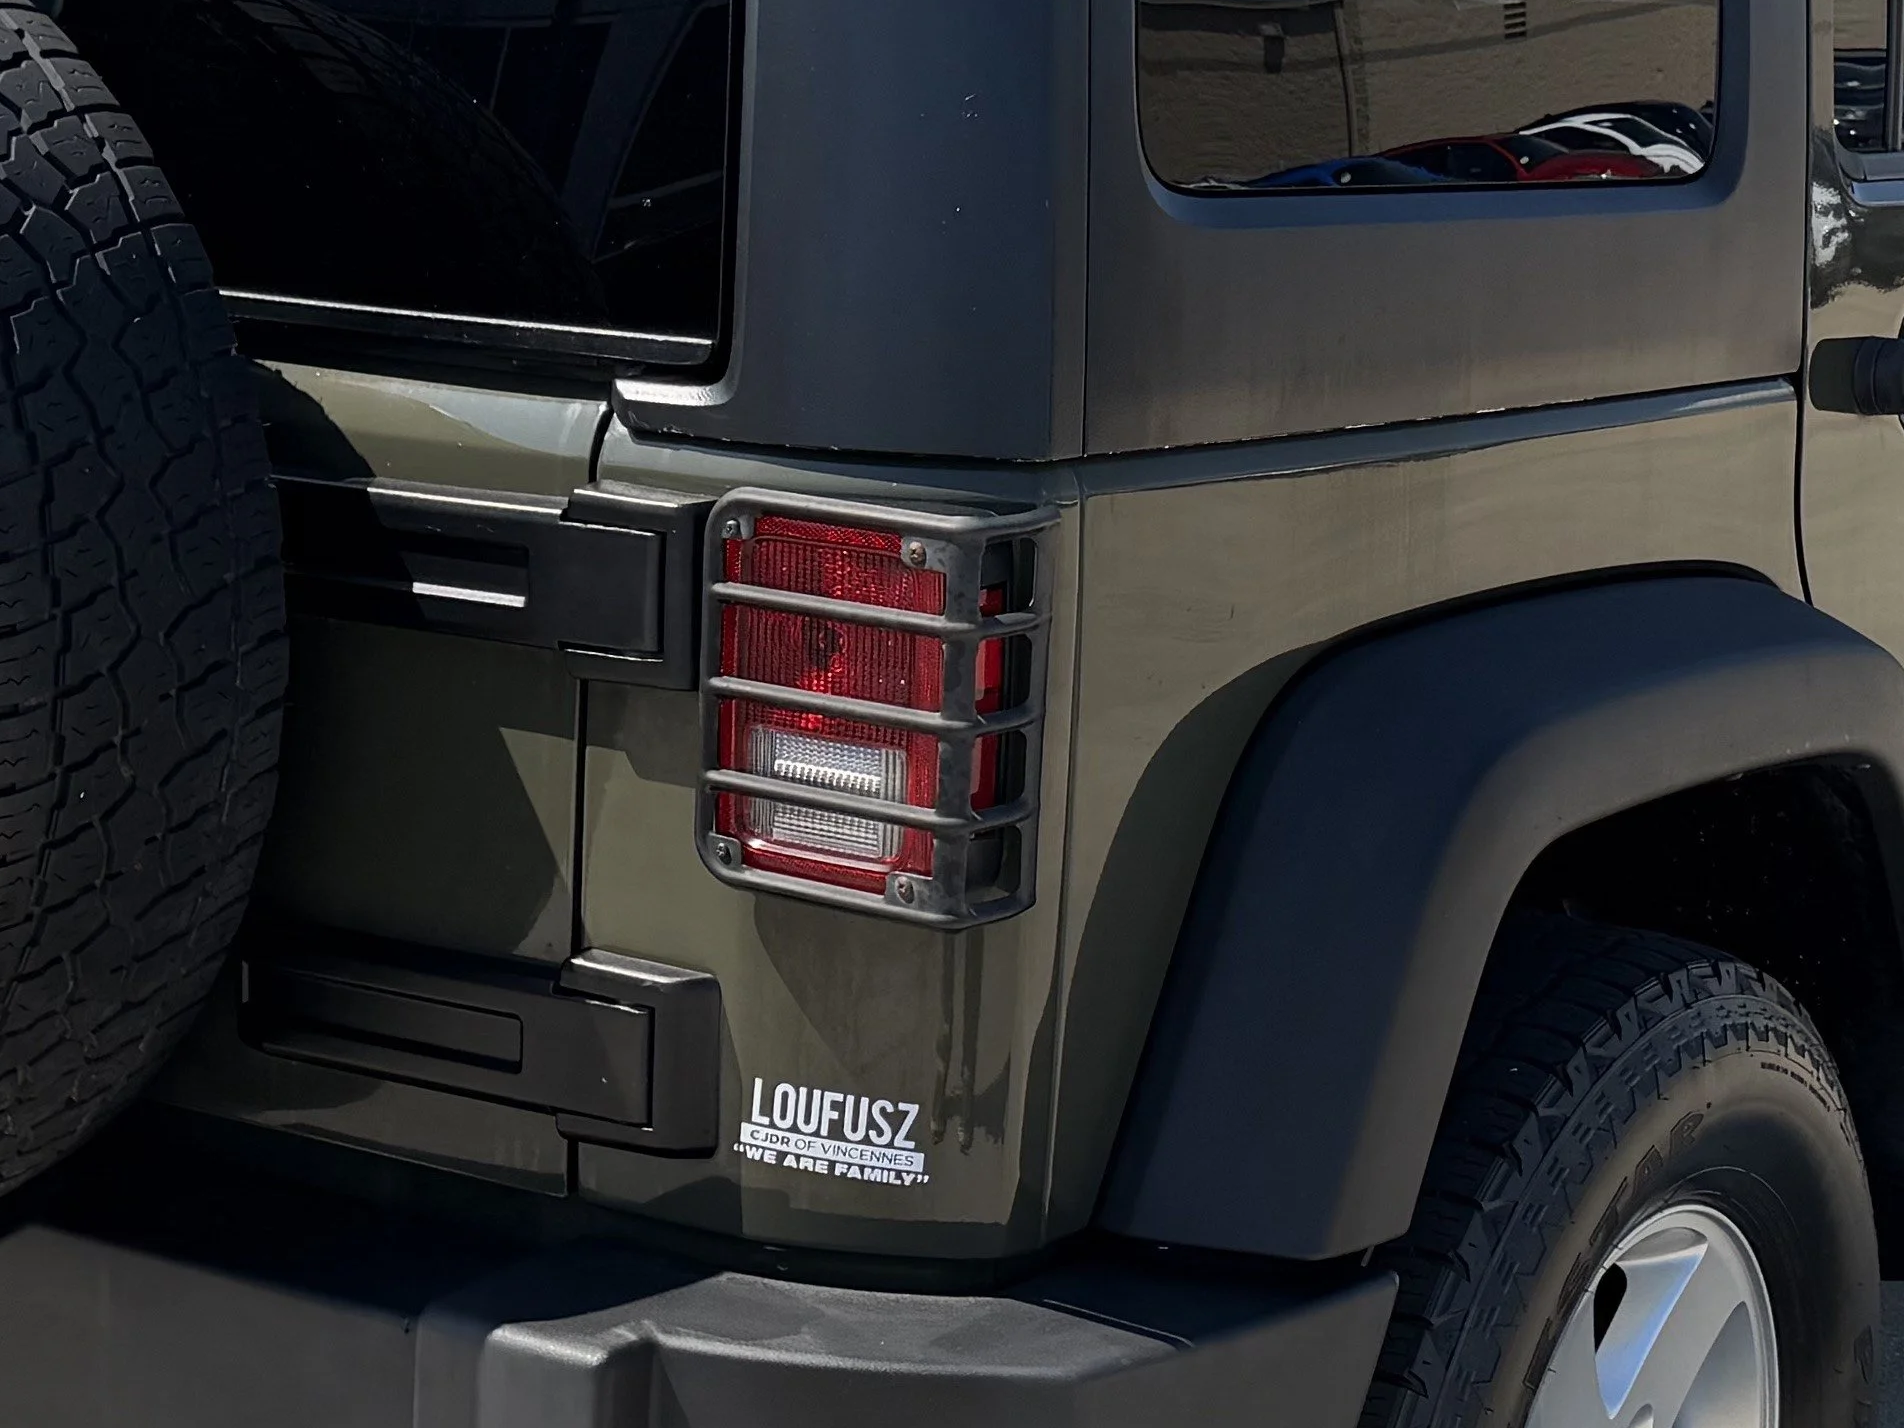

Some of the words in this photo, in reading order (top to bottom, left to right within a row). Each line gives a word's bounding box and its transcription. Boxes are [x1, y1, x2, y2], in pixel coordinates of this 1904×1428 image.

[751, 1076, 920, 1150] LOUFUSZ
[749, 1128, 791, 1149] CJDR
[794, 1138, 818, 1153] OF
[819, 1142, 915, 1167] VINCENNES
[783, 1154, 828, 1175] ARE
